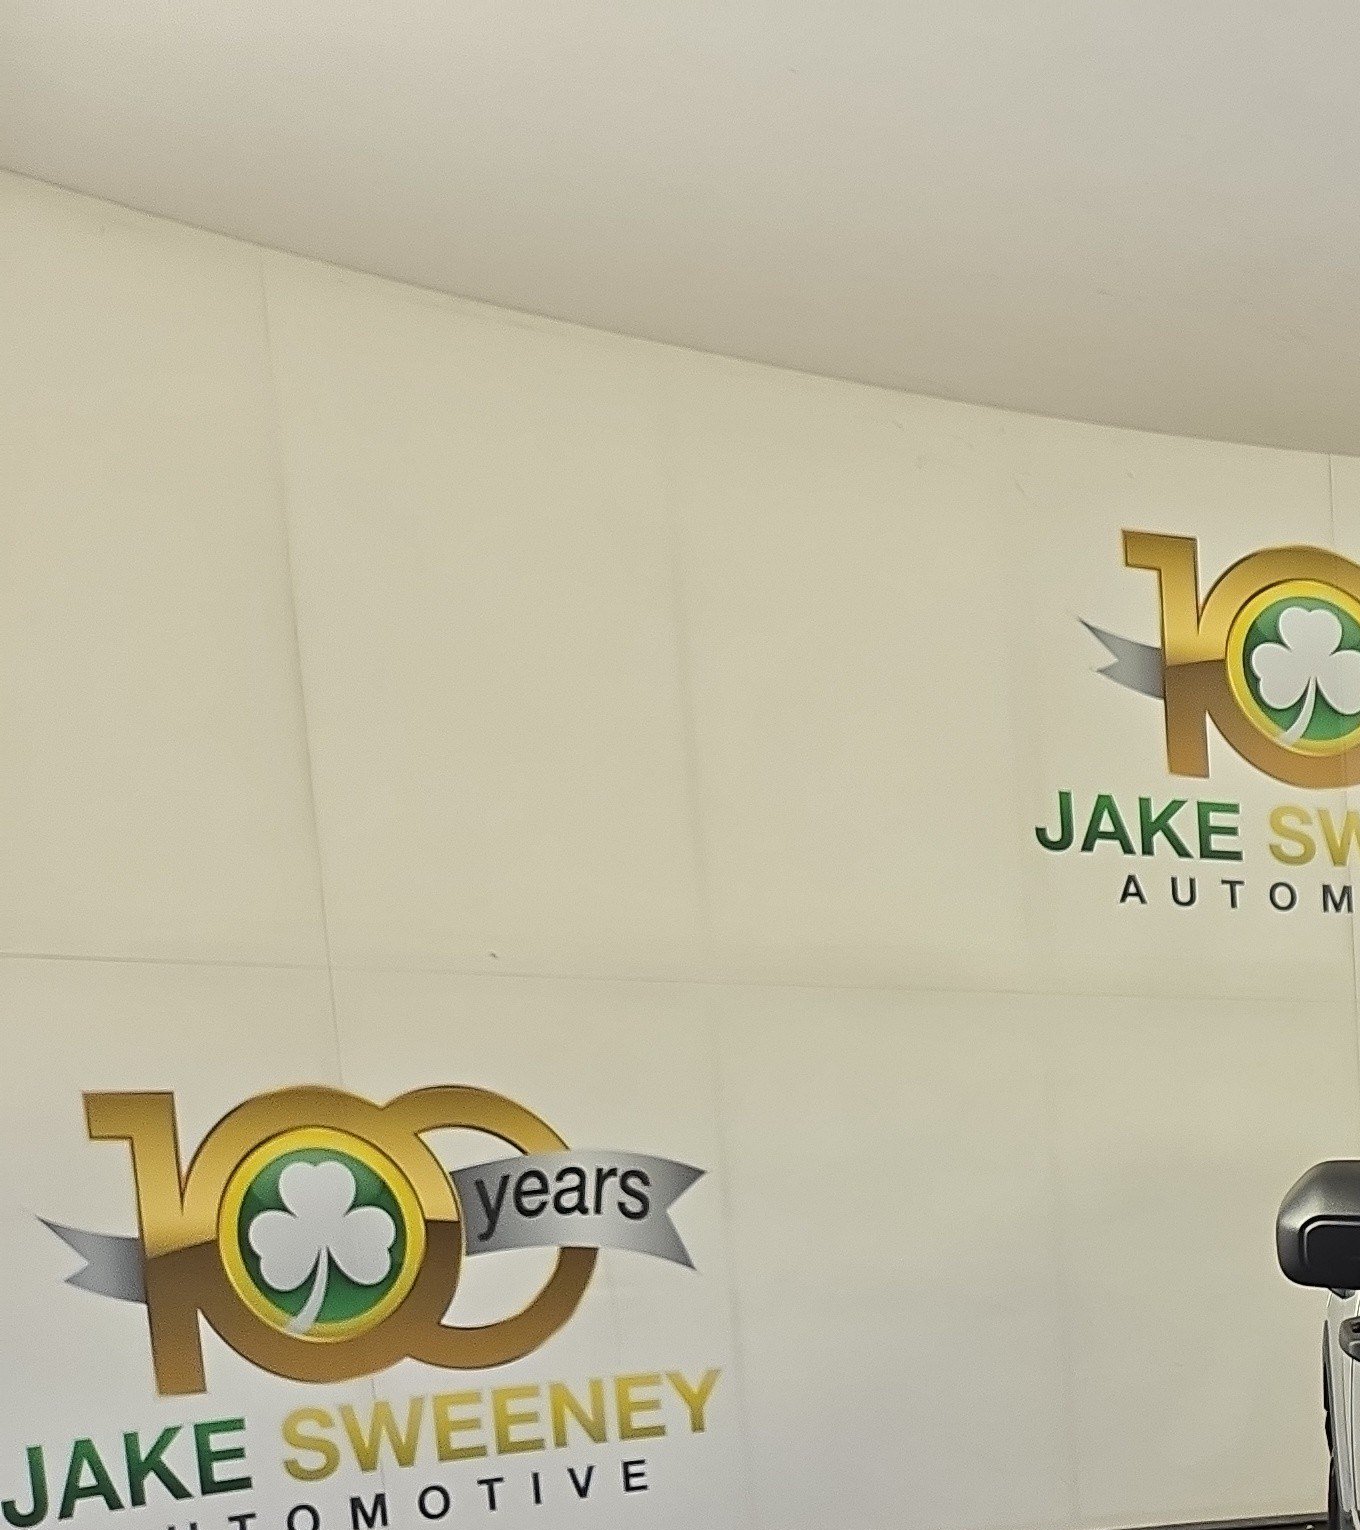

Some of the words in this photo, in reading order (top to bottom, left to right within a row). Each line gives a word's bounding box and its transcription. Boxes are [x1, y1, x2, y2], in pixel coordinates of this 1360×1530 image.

[1035, 790, 1243, 862] JAKE
[82, 1085, 599, 1398] 100
[475, 1165, 653, 1242] years
[1, 1418, 254, 1529] JAKE
[280, 1369, 723, 1483] SWEENEY
